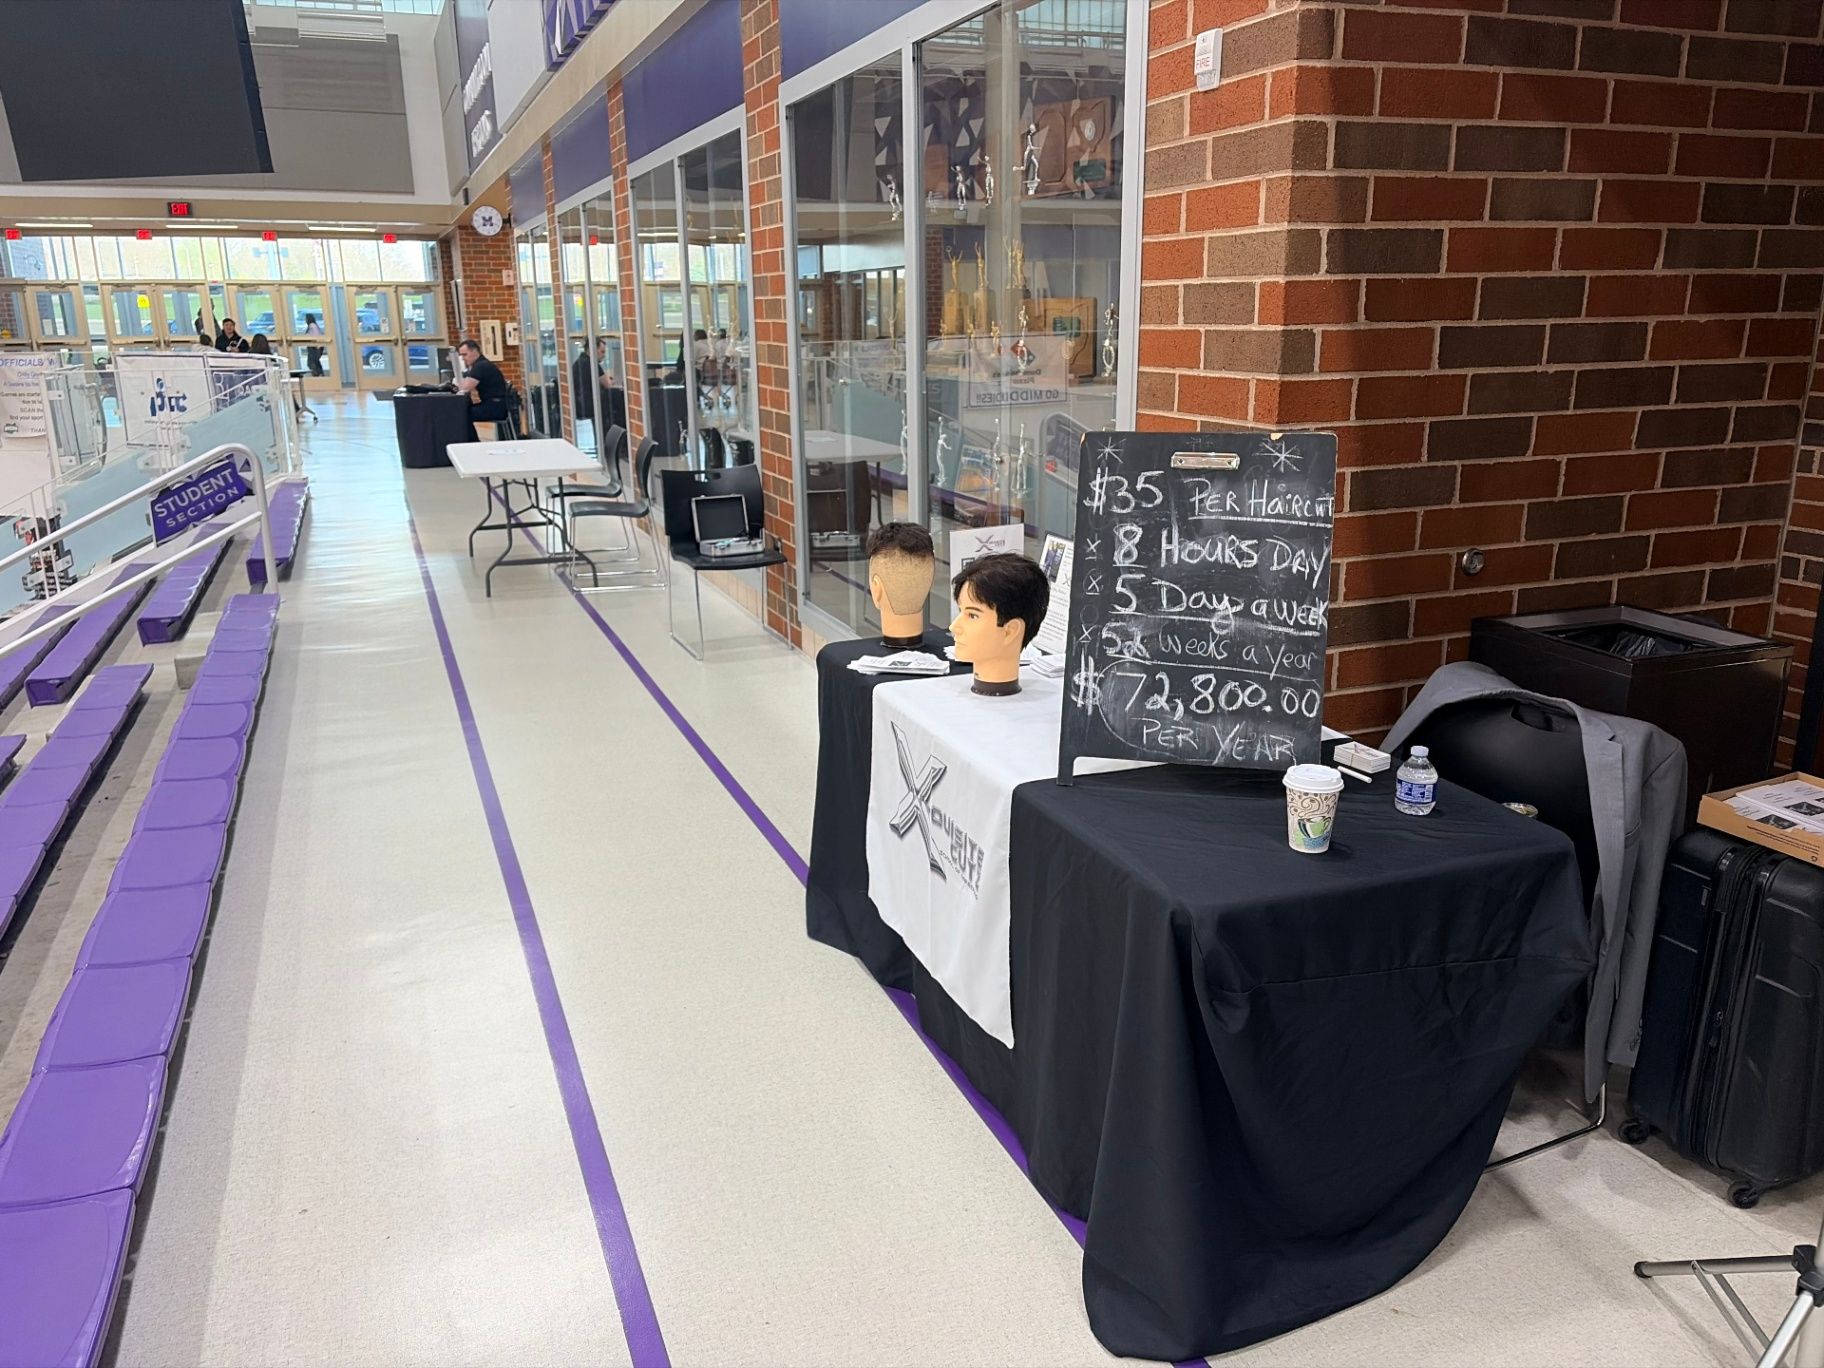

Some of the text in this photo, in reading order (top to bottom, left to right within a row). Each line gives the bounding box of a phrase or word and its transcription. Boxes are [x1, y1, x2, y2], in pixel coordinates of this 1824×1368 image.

[154, 468, 234, 518] STUDENT
[166, 487, 239, 527] SECTION
[1083, 466, 1165, 516] $35
[1112, 523, 1144, 565] 8
[1112, 573, 1146, 613] 5
[1242, 645, 1260, 665] a
